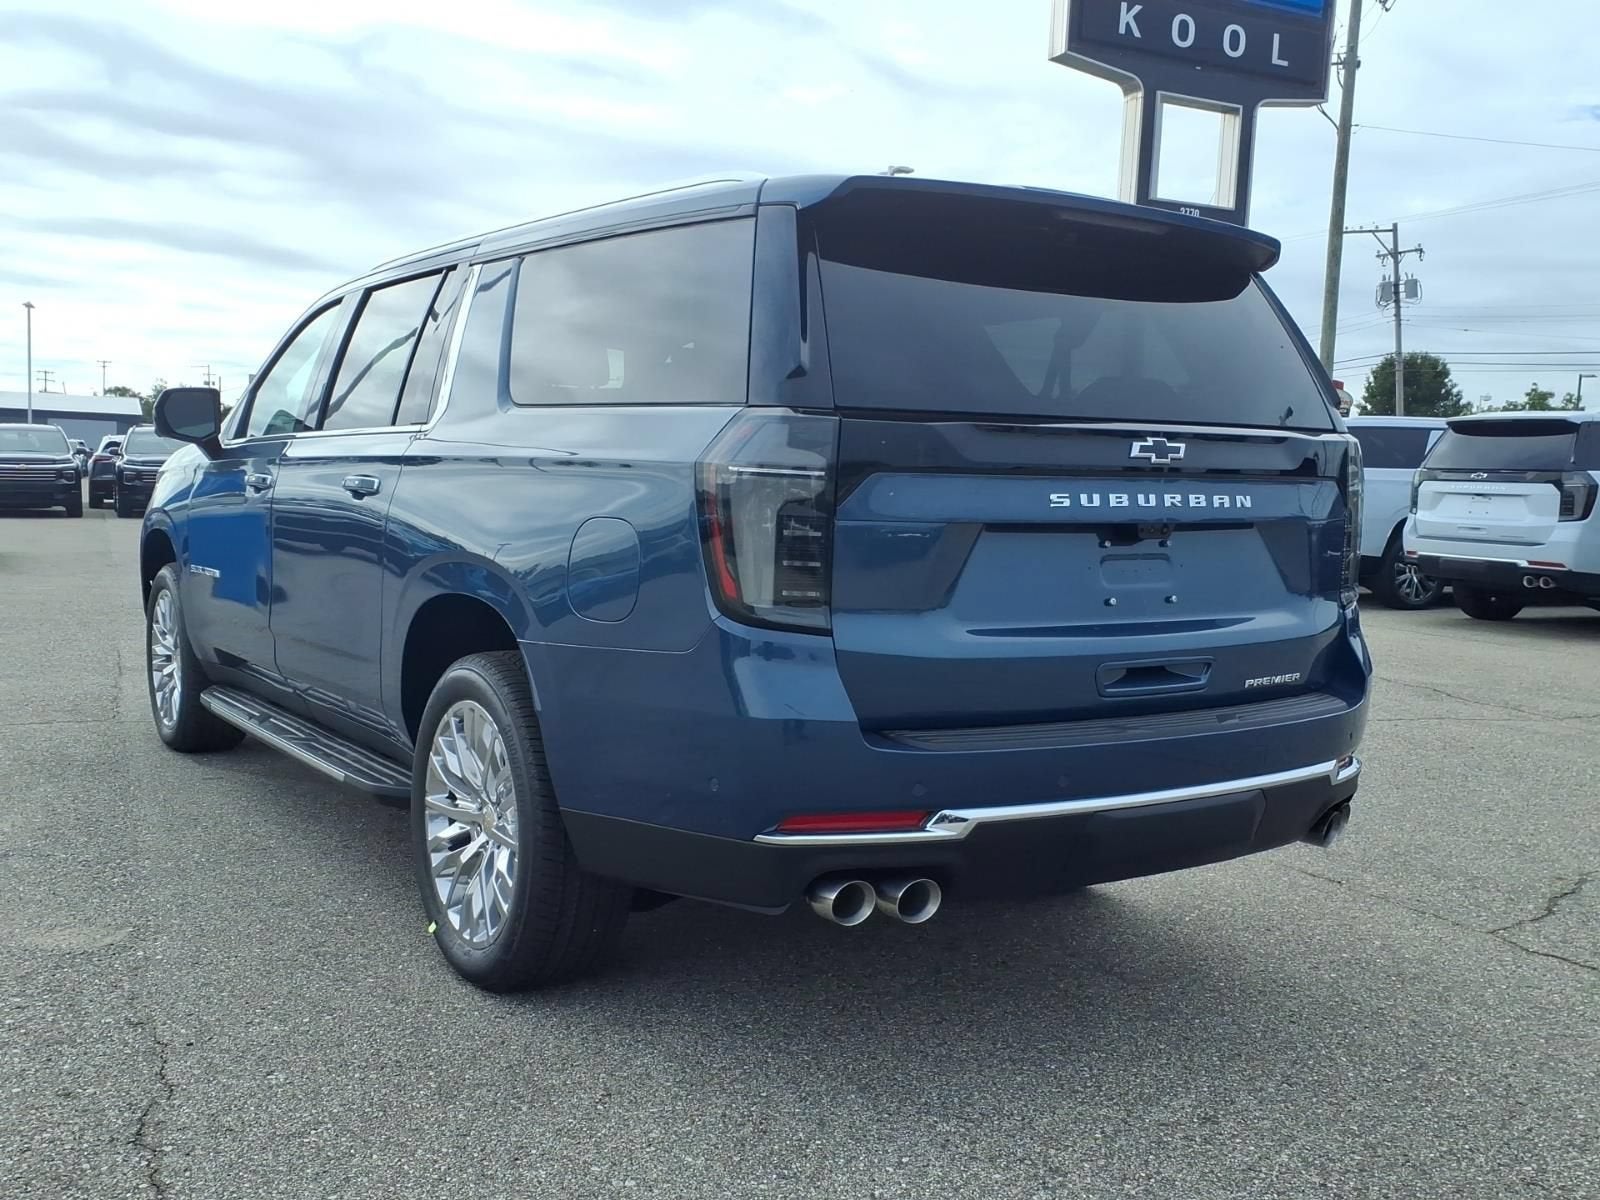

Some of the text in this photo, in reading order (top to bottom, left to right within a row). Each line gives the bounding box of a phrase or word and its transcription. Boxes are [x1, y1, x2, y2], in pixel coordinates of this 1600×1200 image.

[1118, 2, 1289, 67] KOOL
[1050, 493, 1252, 508] SUBURBAN
[1245, 672, 1301, 689] PREMIER
